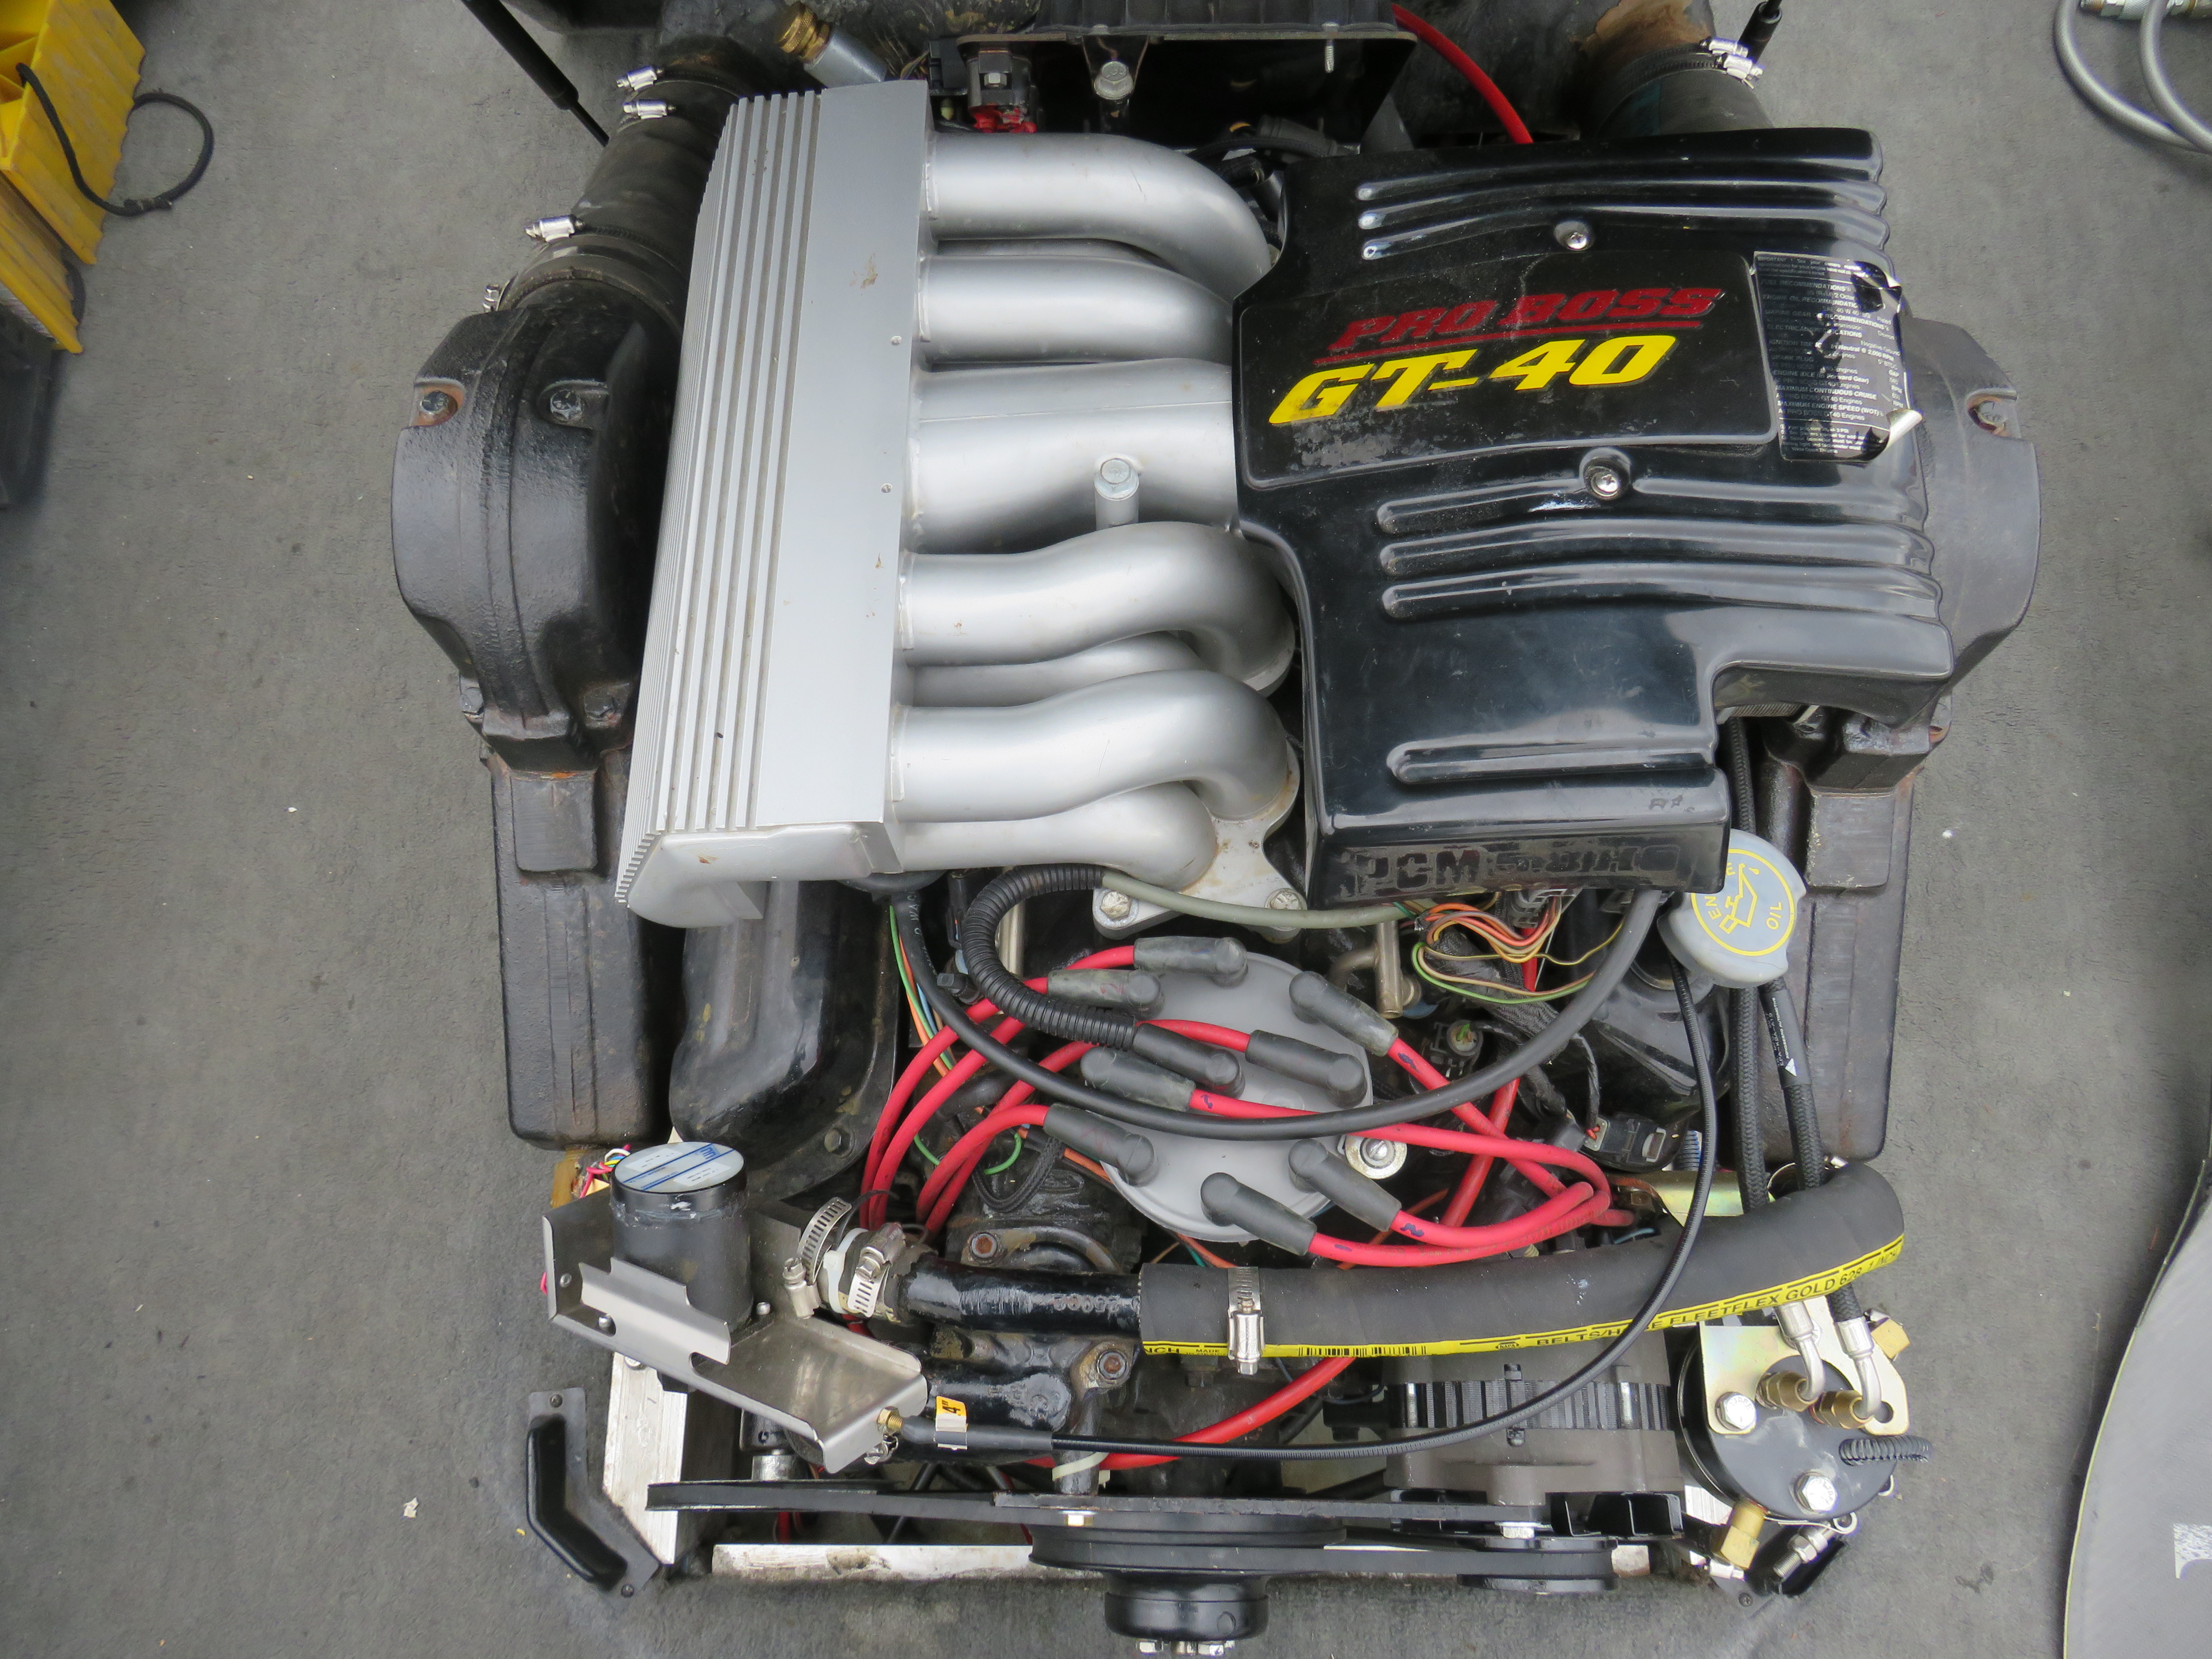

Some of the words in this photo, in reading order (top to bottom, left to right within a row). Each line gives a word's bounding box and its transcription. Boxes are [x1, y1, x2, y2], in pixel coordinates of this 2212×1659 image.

[1802, 296, 1858, 309] RECOMMENDATIO
[1328, 300, 1499, 352] PRO
[1497, 288, 1726, 326] BOSS
[1268, 335, 1676, 425] GT-40
[1838, 404, 1860, 413] SPEED
[1854, 391, 1877, 400] CRUISE
[1766, 901, 1783, 930] OIL
[1537, 1321, 1663, 1345] BELTS/HE
[1669, 1295, 1780, 1324] FLEETFLEX
[1785, 1278, 1836, 1301] GOLD
[1839, 1267, 1862, 1286] 628
